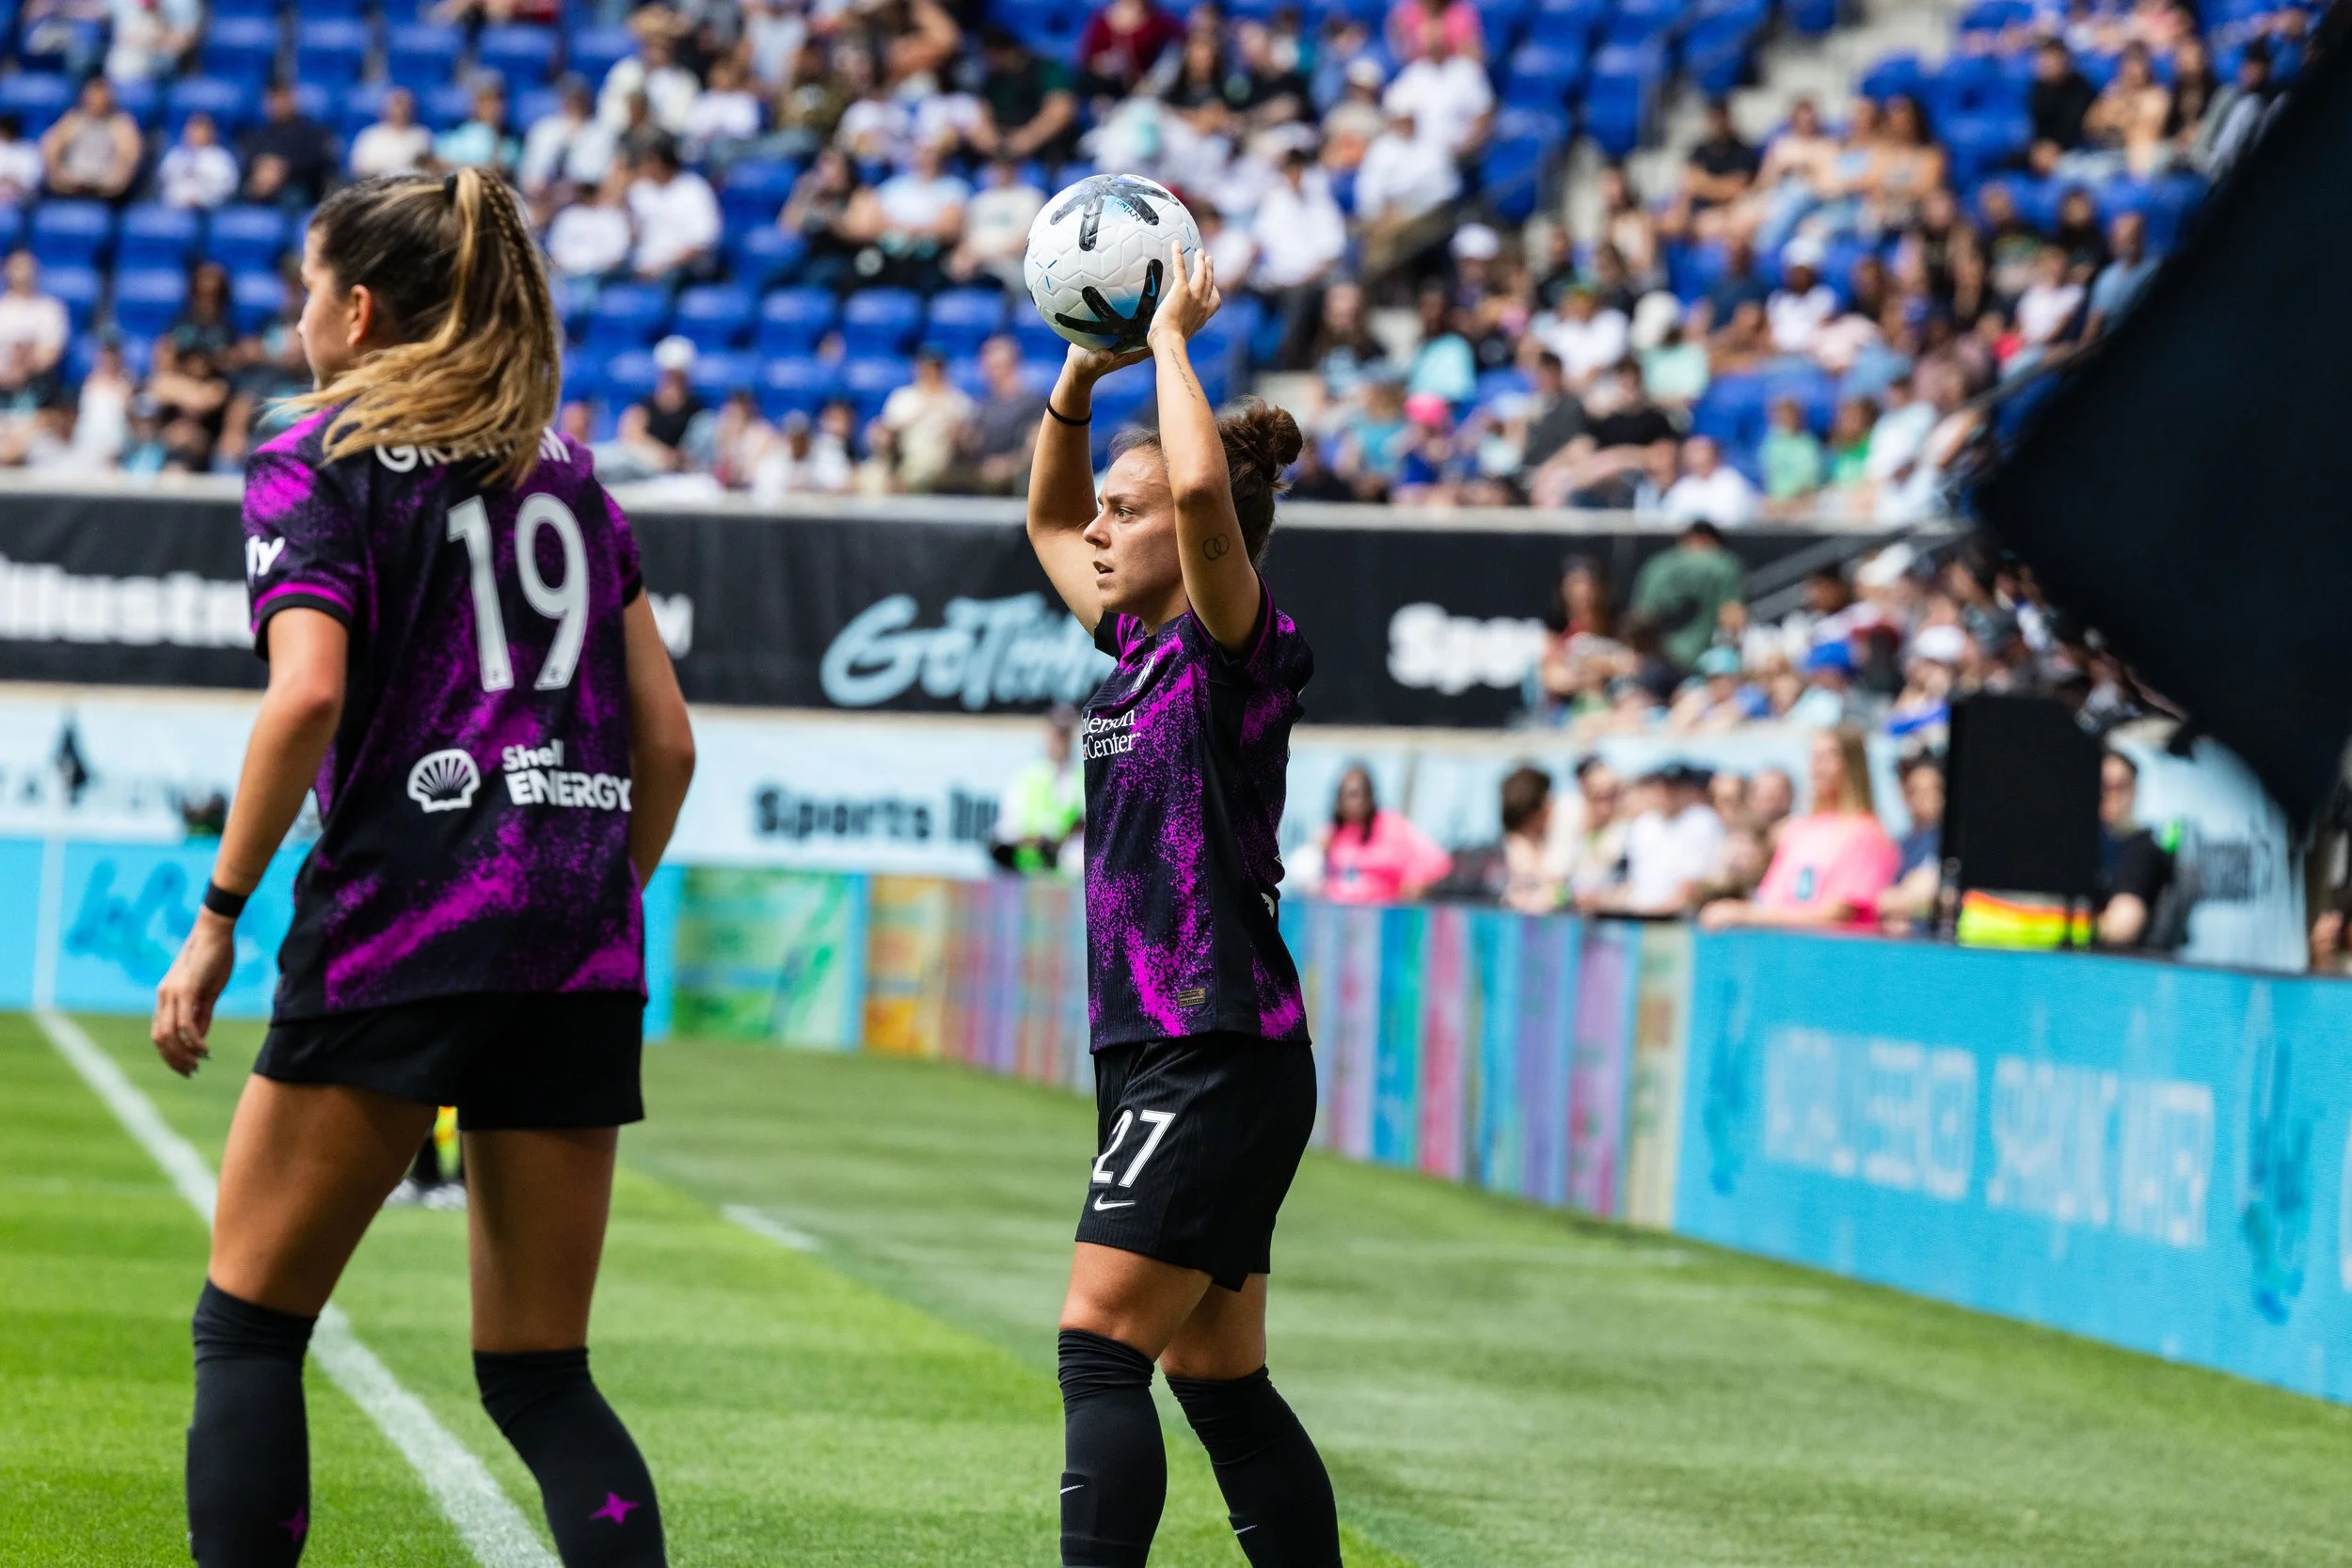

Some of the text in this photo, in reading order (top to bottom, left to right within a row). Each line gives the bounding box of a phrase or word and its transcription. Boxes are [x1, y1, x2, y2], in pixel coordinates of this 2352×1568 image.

[447, 492, 591, 692] 19
[505, 769, 633, 812] ENERGY
[755, 788, 930, 841] Sports
[1092, 1109, 1176, 1188] 27
